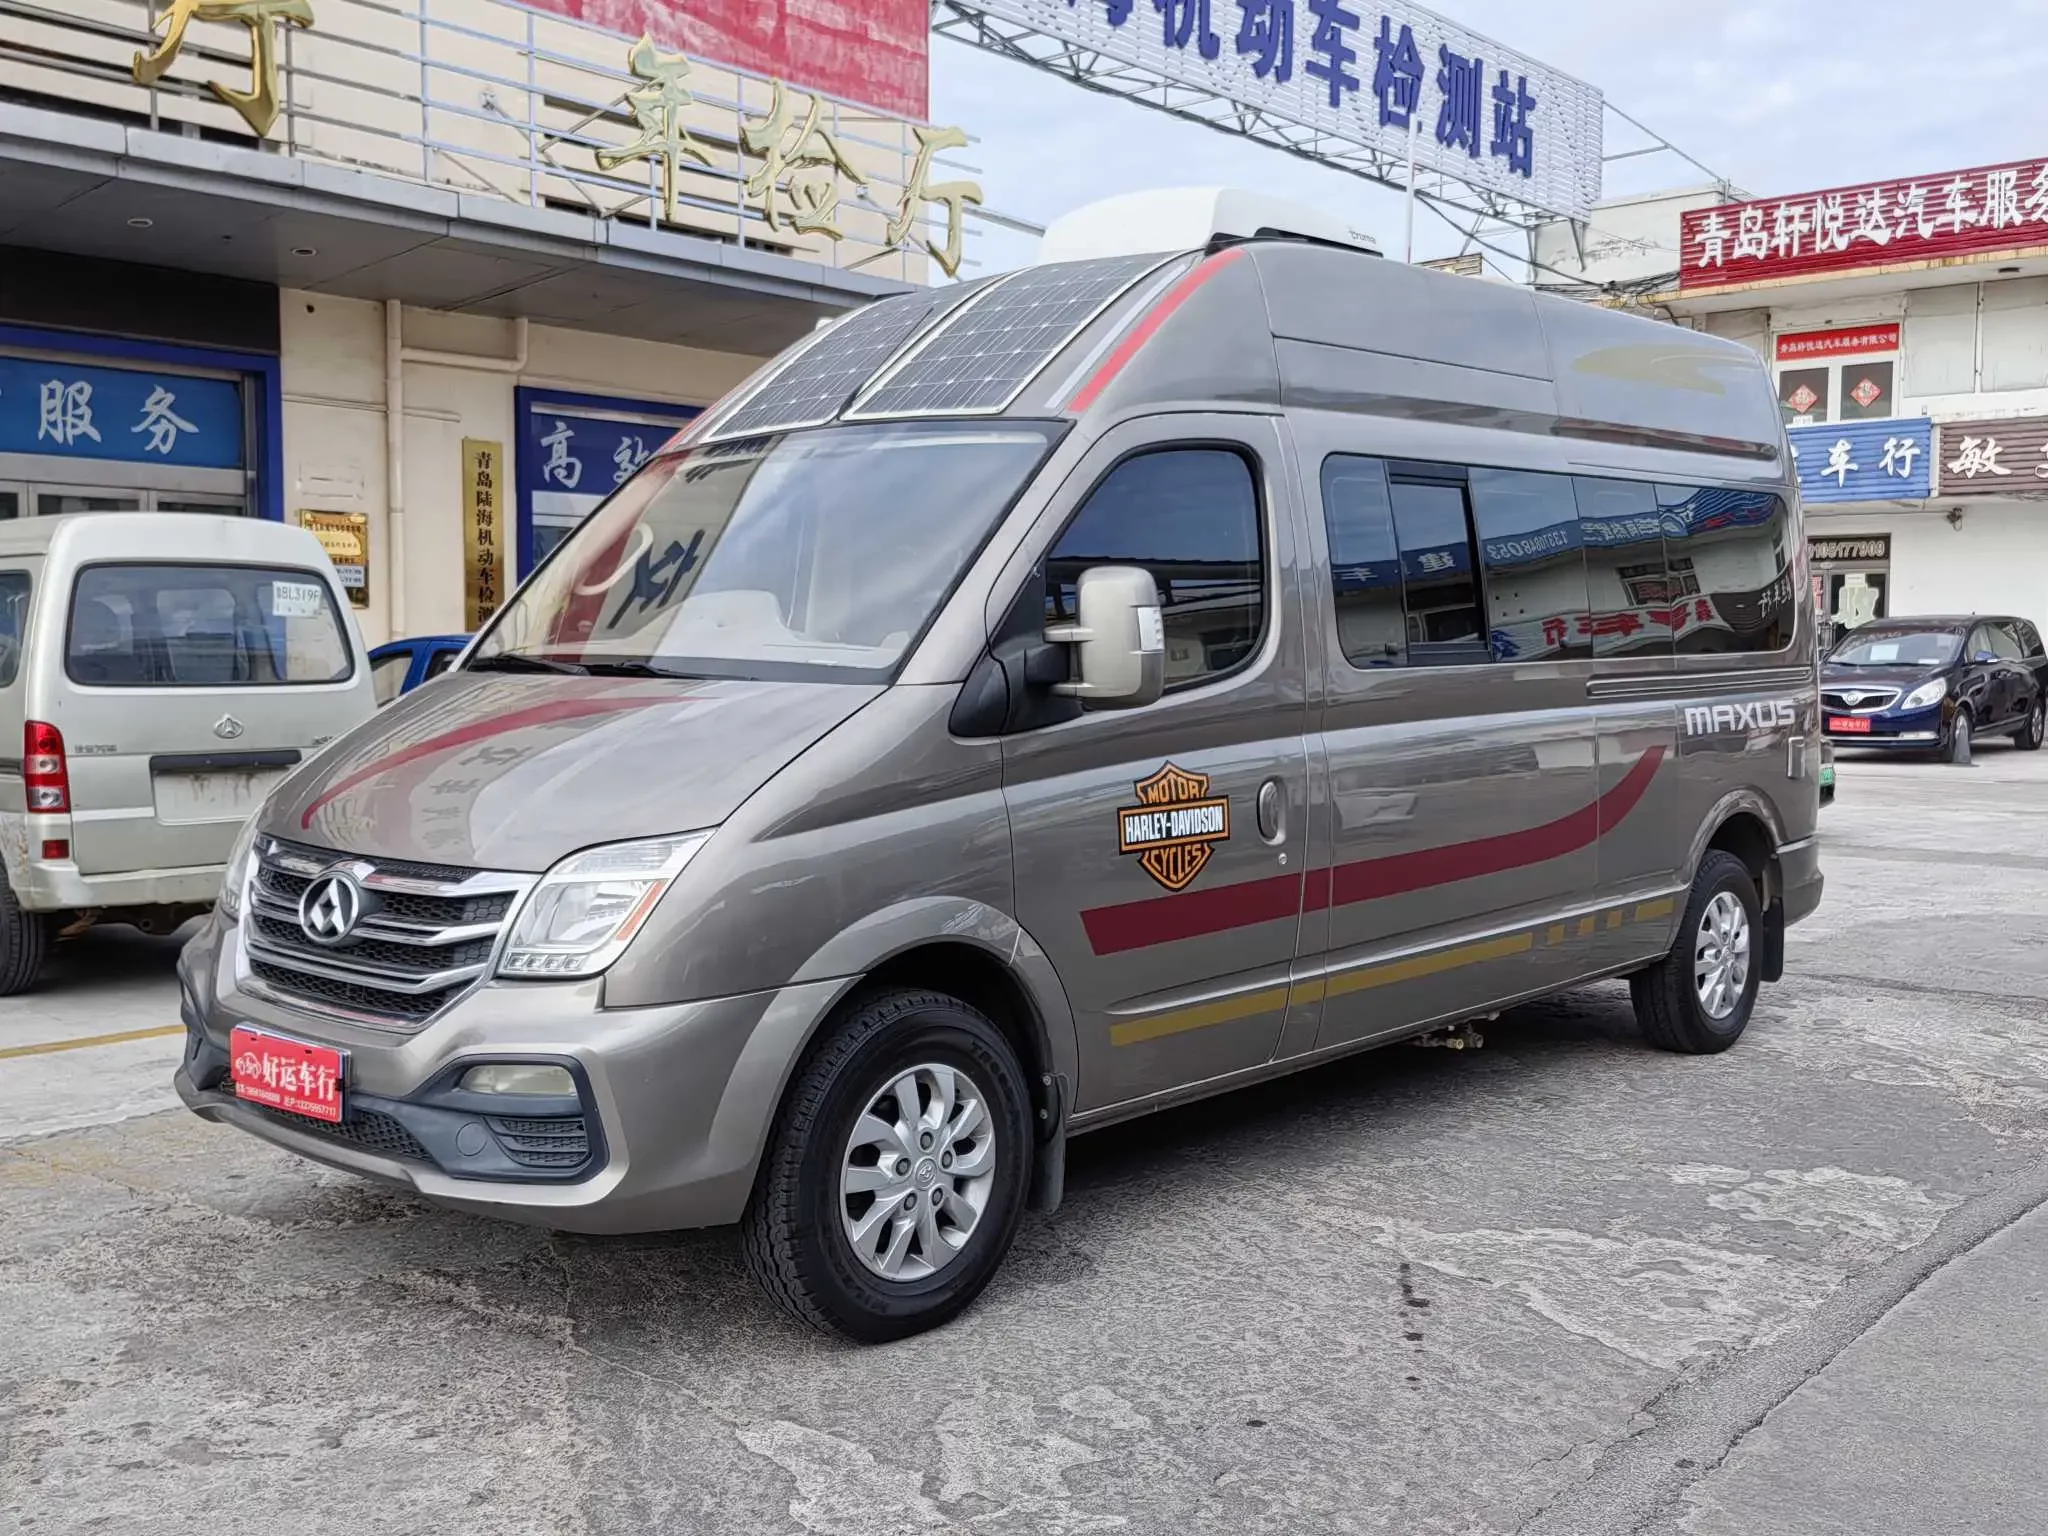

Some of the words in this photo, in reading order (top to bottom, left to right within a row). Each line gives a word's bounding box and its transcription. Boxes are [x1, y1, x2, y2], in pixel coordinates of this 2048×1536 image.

[1072, 0, 1535, 178] 机动车检测站
[1788, 436, 1921, 488] 车行
[1947, 435, 2048, 480] 敏
[1684, 699, 1796, 735] MAXUS
[1147, 772, 1200, 804] MOTOR
[1125, 805, 1224, 844] HARLEY-DAVIDSON
[1150, 842, 1202, 882] CYCLES
[263, 1052, 336, 1101] 好运车行
